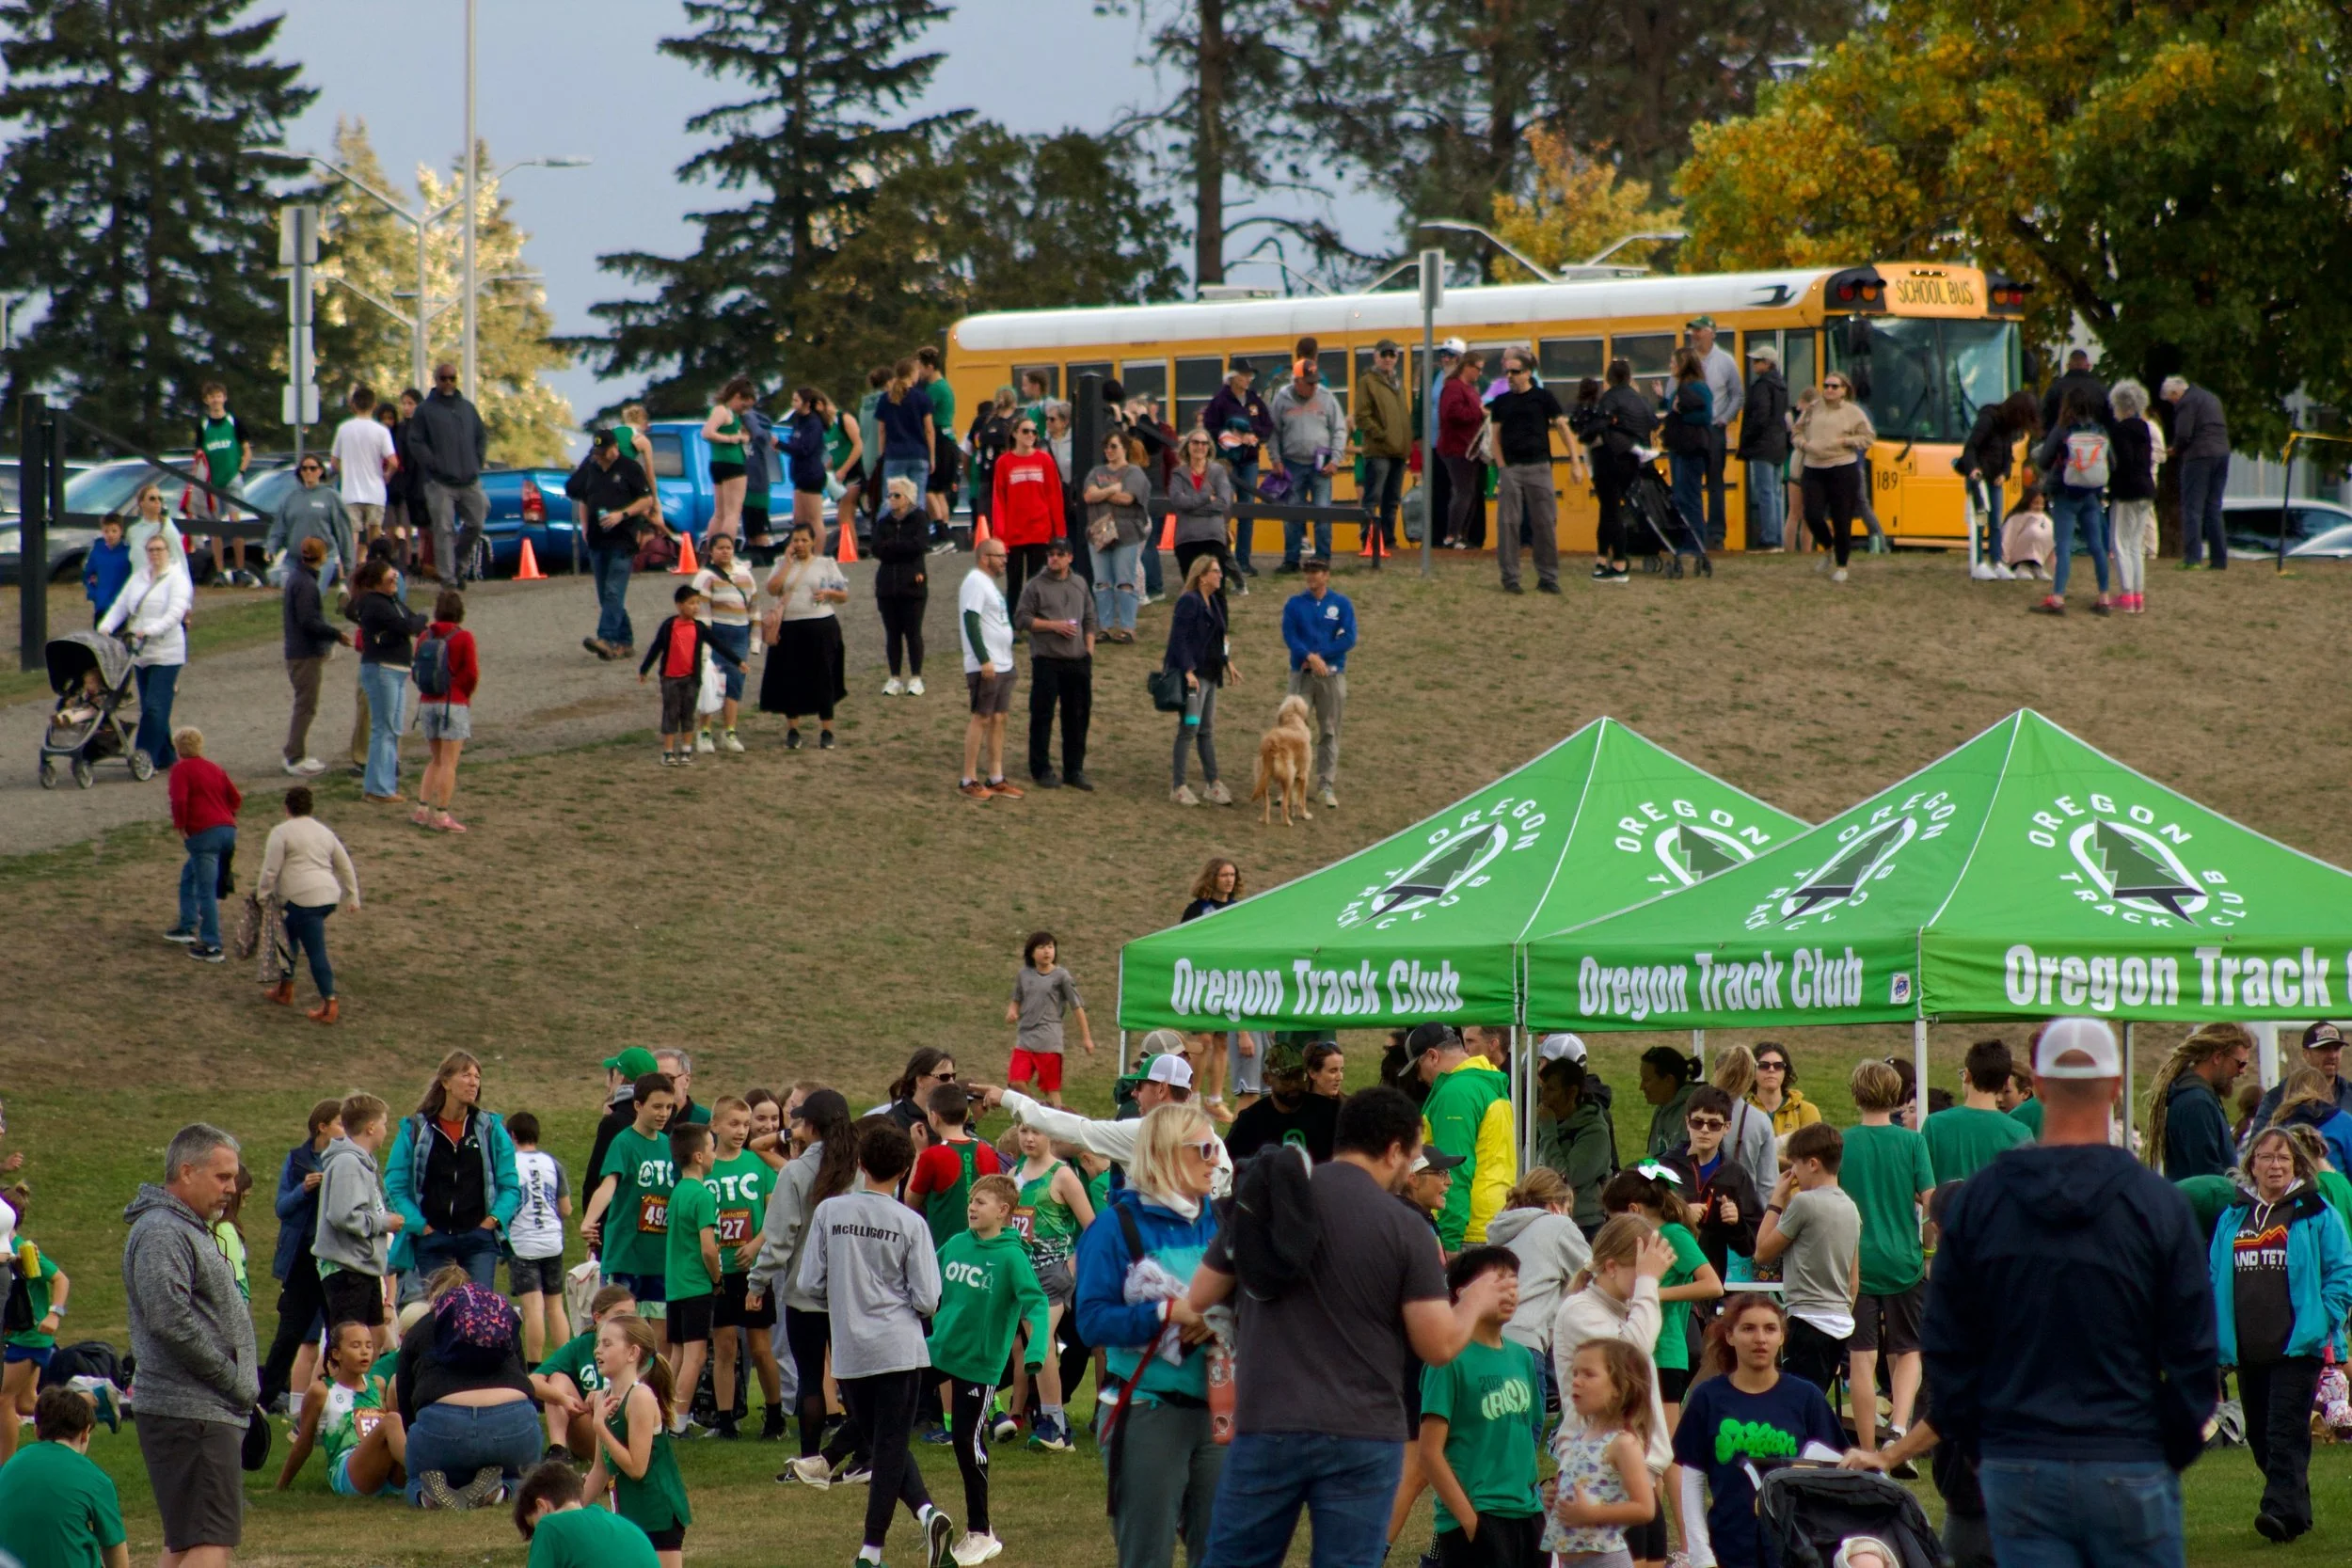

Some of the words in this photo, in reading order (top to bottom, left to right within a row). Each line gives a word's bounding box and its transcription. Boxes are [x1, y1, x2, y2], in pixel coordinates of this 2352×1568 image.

[1896, 279, 1947, 305] SCHOOL
[1947, 281, 1974, 306] BUS
[1876, 471, 1899, 491] 189
[1428, 798, 1547, 851] OREGON
[1614, 800, 1772, 853] OREGON
[1837, 792, 1957, 841] OREGON
[2028, 793, 2193, 848] OREGON
[1337, 867, 1404, 929] TRACK
[1375, 875, 1491, 930] CLUB
[1744, 868, 1814, 930] TRACK
[1784, 863, 1897, 931] CLUB
[2059, 871, 2174, 929] TRACK
[2201, 870, 2248, 927] CLUB
[1170, 958, 1284, 1022] Oregon
[1292, 959, 1381, 1016] Track
[1387, 959, 1464, 1014] Club
[1578, 956, 1690, 1022] Oregon
[1694, 951, 1784, 1012] Track
[1790, 946, 1864, 1009] Club
[2005, 944, 2179, 1012] Oregon
[2194, 946, 2332, 1007] Track
[832, 1224, 899, 1243] McELLIGOTT
[2261, 1249, 2288, 1265] TET
[945, 1260, 984, 1288] OTC
